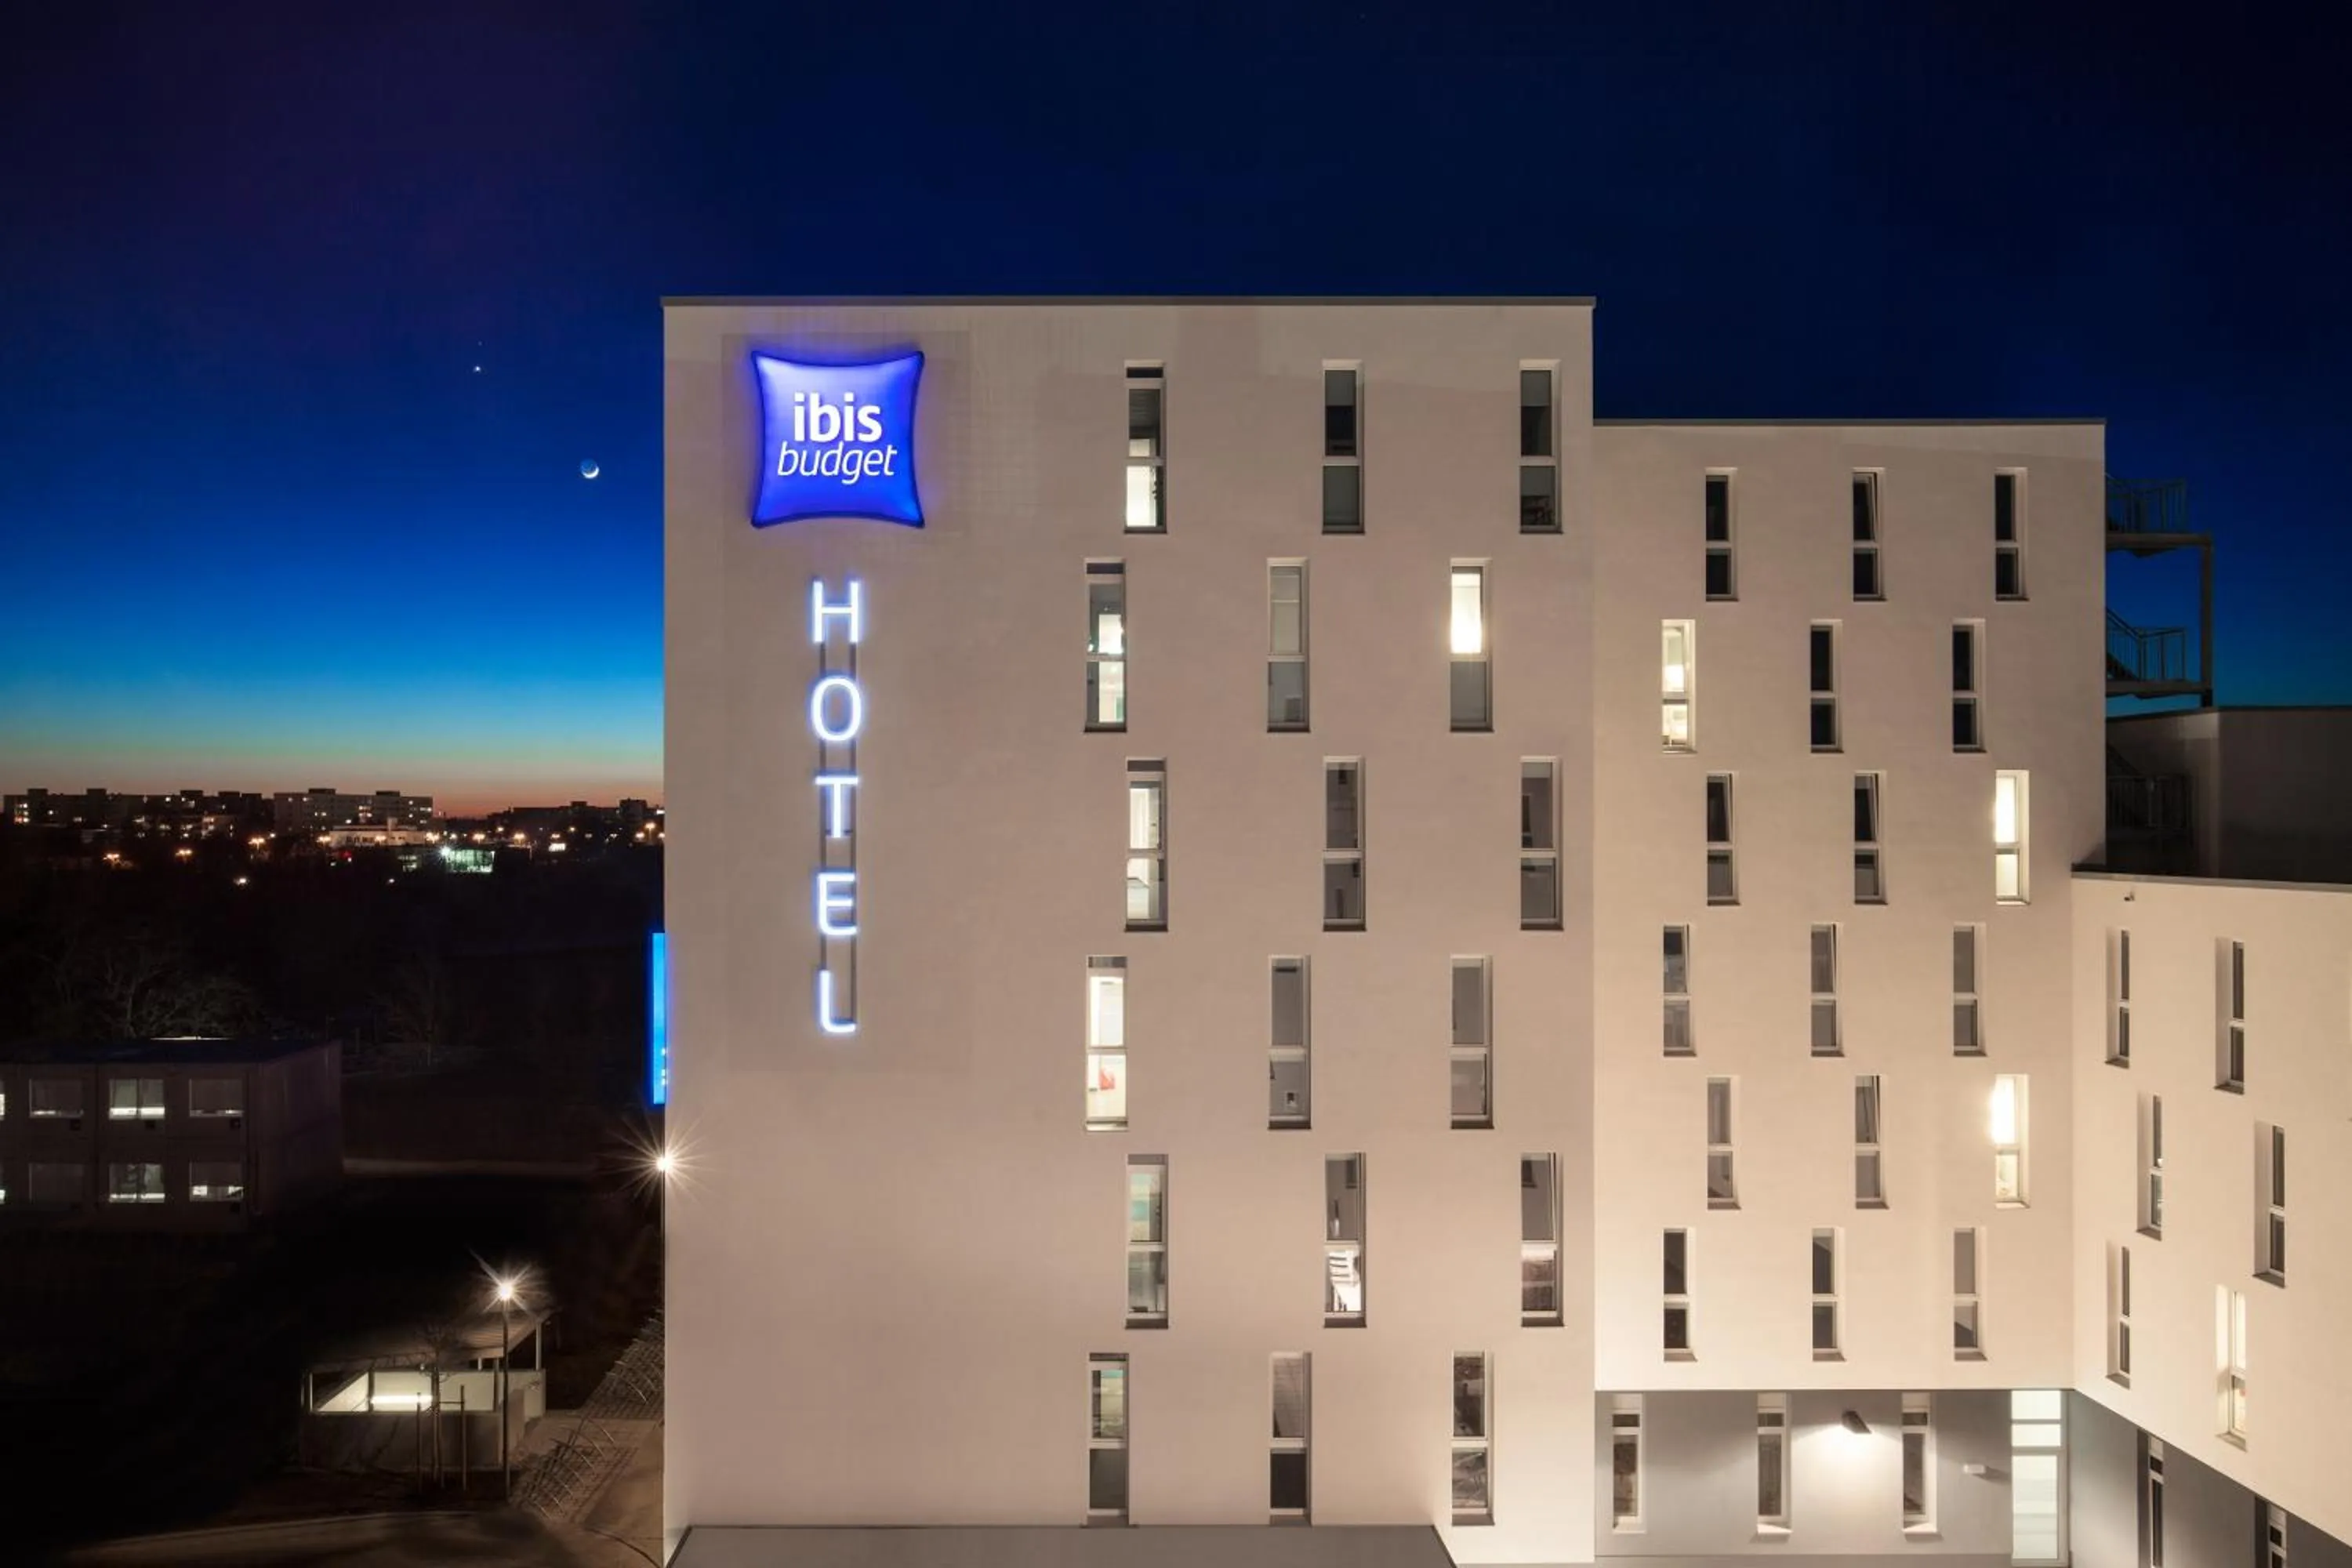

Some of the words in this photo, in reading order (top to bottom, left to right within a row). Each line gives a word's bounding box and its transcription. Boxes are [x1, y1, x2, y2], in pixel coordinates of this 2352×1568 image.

[793, 392, 883, 442] ibis
[777, 441, 898, 485] budget
[811, 580, 862, 1033] HOTEL
